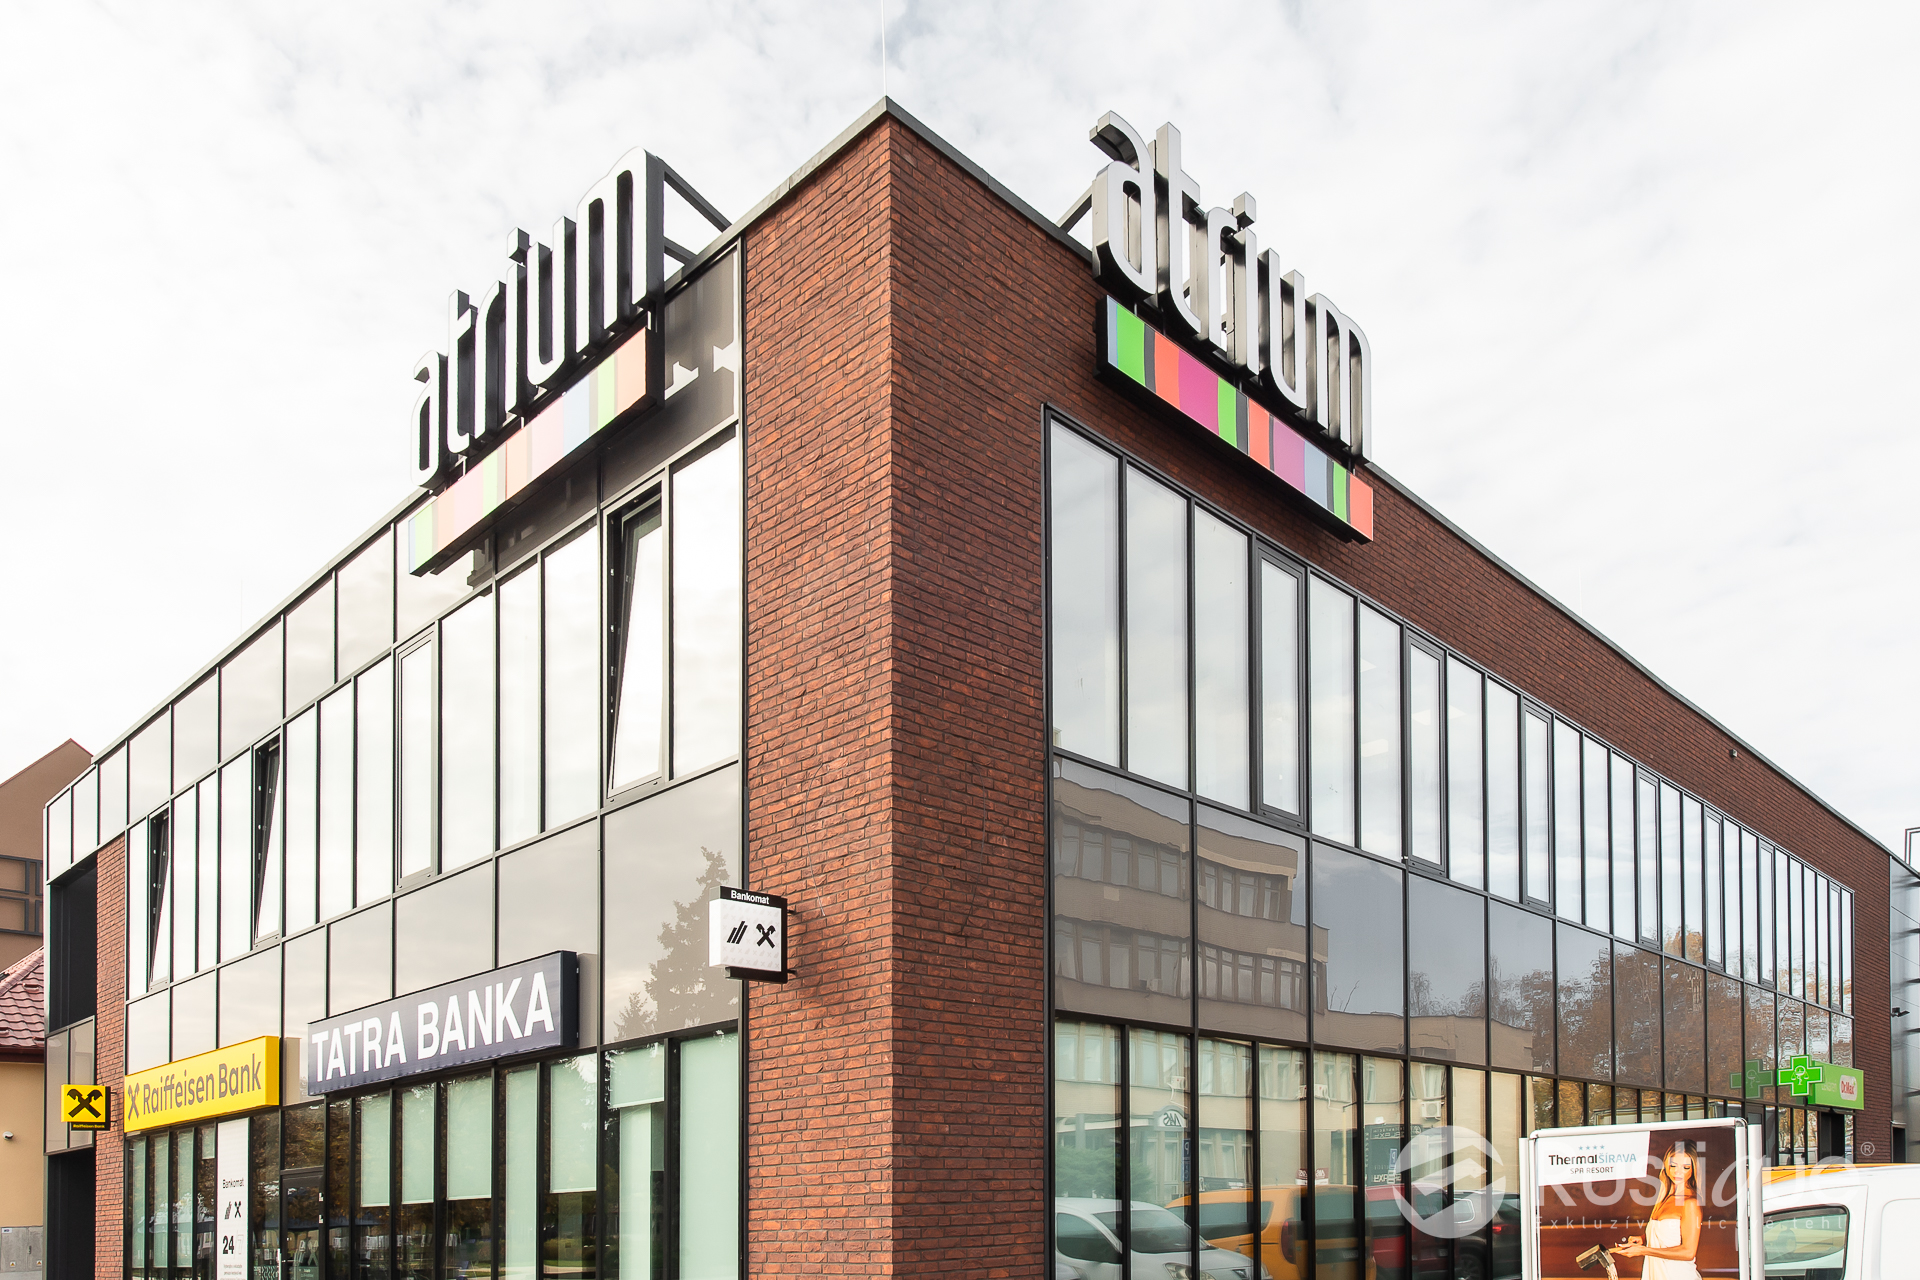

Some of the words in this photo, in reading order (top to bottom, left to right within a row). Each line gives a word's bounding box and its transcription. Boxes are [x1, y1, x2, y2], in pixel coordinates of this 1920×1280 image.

[1090, 110, 1372, 464] atrium
[411, 146, 660, 492] atrium
[730, 890, 770, 905] Bankomat
[311, 1010, 407, 1083] TATRA
[417, 971, 555, 1061] BANKA
[143, 1069, 215, 1115] Raiffeisen
[218, 1053, 262, 1099] Bank
[222, 1178, 245, 1189] Bankomat
[1586, 1166, 1614, 1174] RESORT
